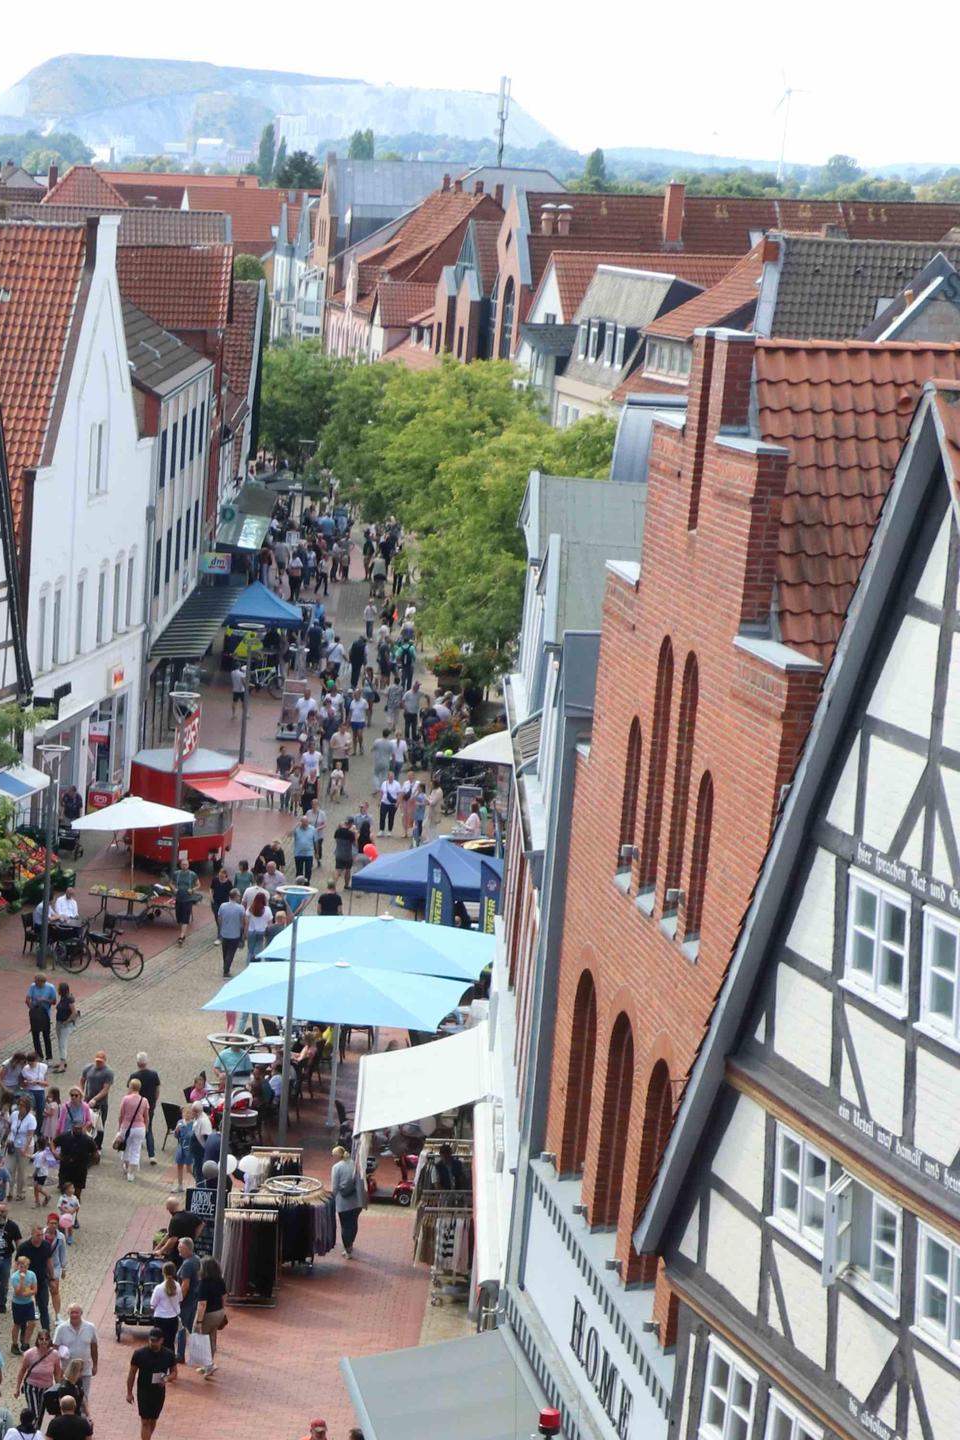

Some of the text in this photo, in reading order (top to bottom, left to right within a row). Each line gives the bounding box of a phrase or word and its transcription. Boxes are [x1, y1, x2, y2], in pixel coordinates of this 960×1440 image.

[211, 557, 225, 566] dm
[930, 883, 946, 902] und
[190, 1203, 215, 1216] BREEZE
